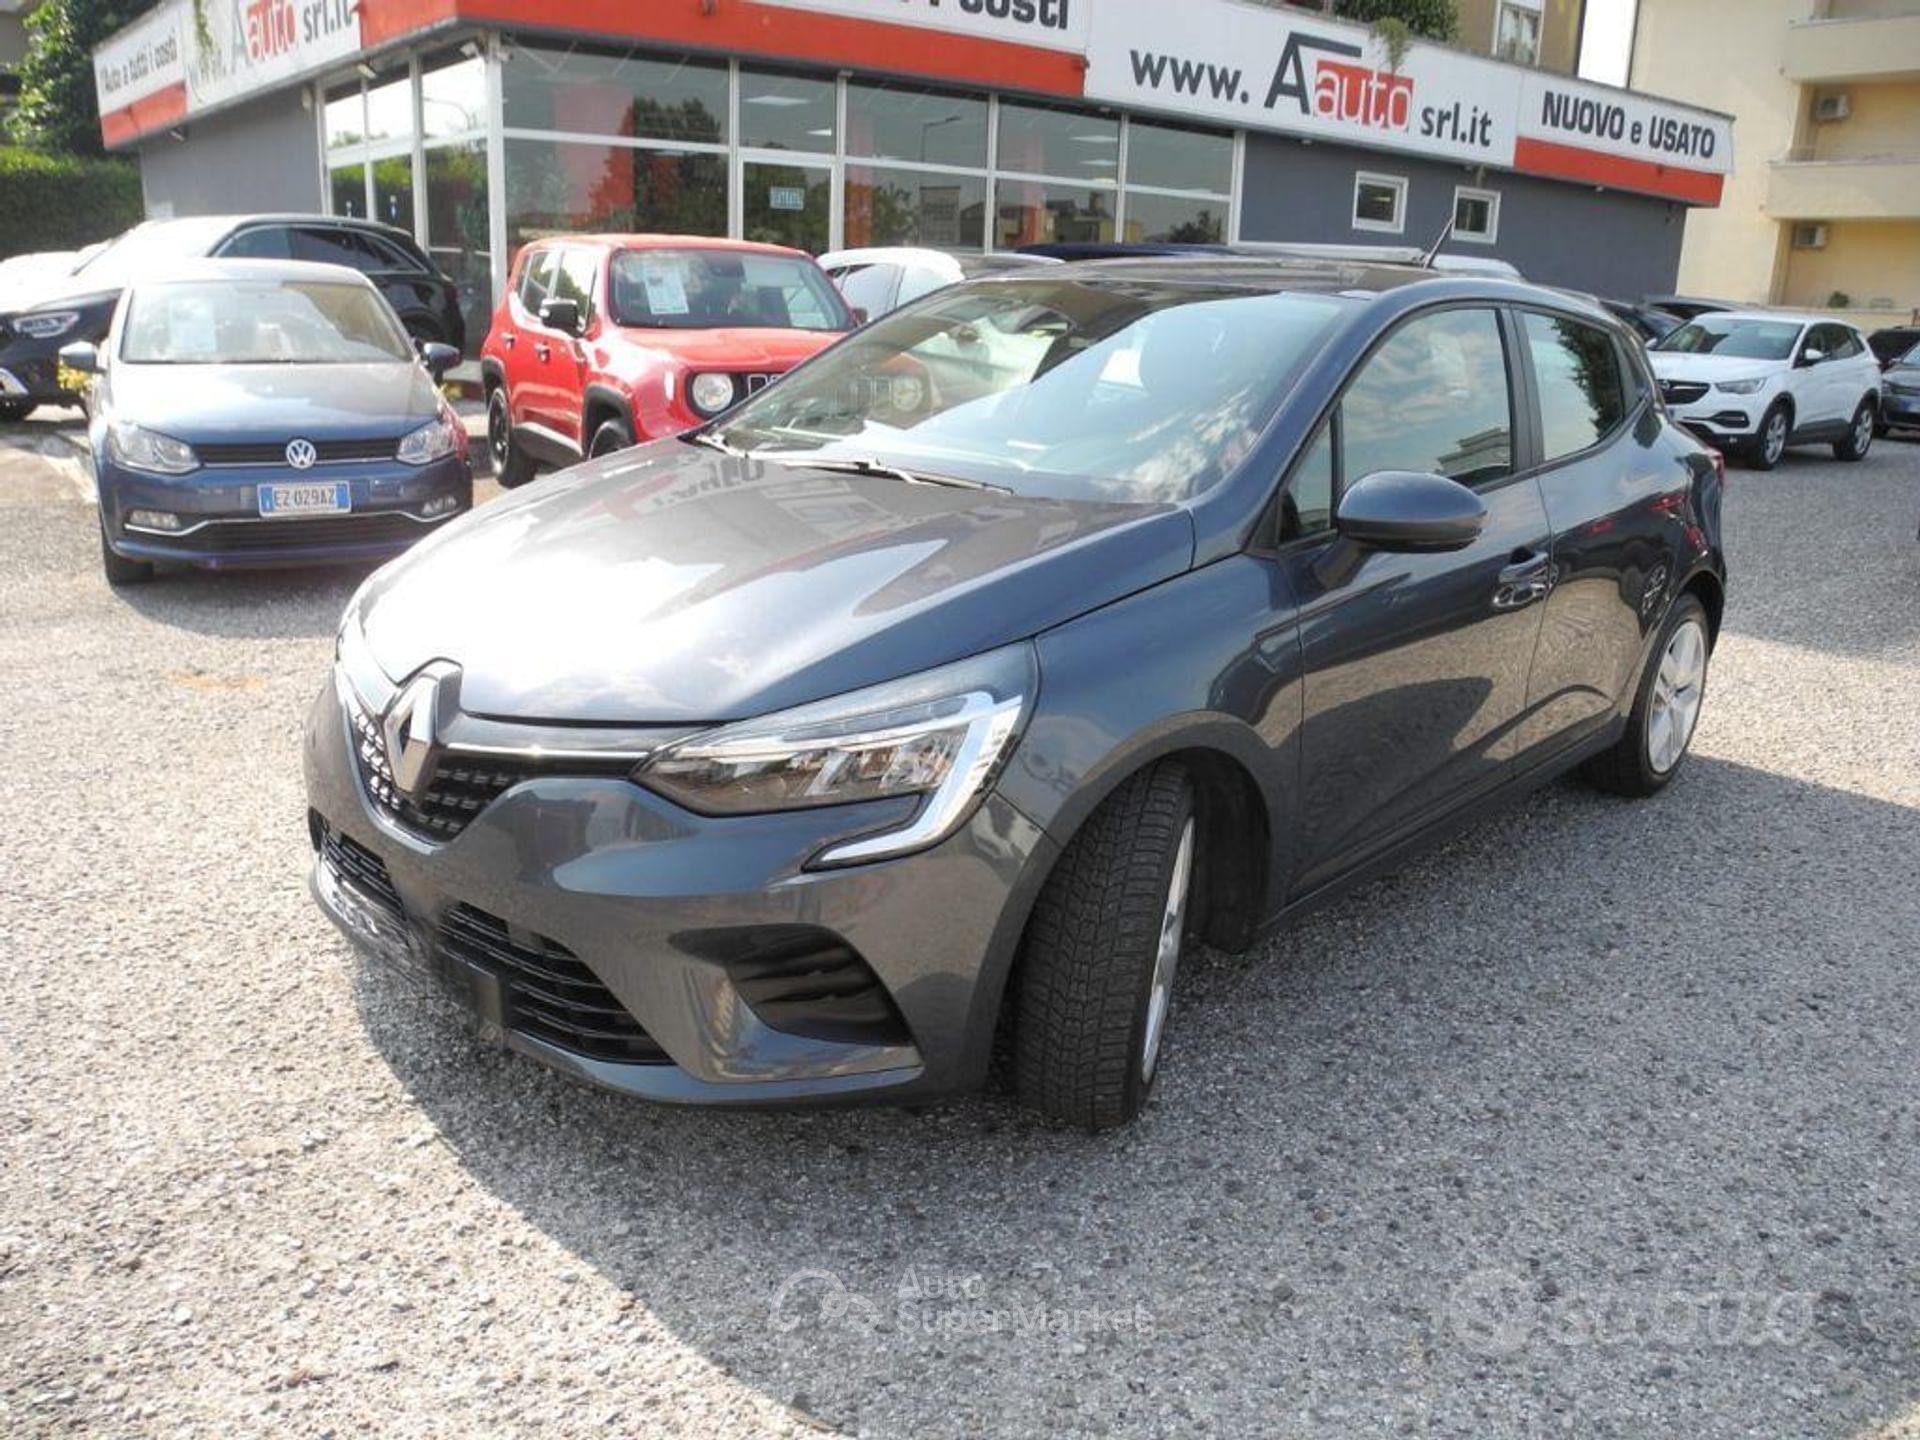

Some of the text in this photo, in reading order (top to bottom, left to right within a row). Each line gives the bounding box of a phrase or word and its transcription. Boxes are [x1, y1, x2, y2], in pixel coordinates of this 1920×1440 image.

[1130, 49, 1250, 104] www.
[1420, 101, 1493, 148] srl.it
[1541, 90, 1716, 159] NUOVO e USATO
